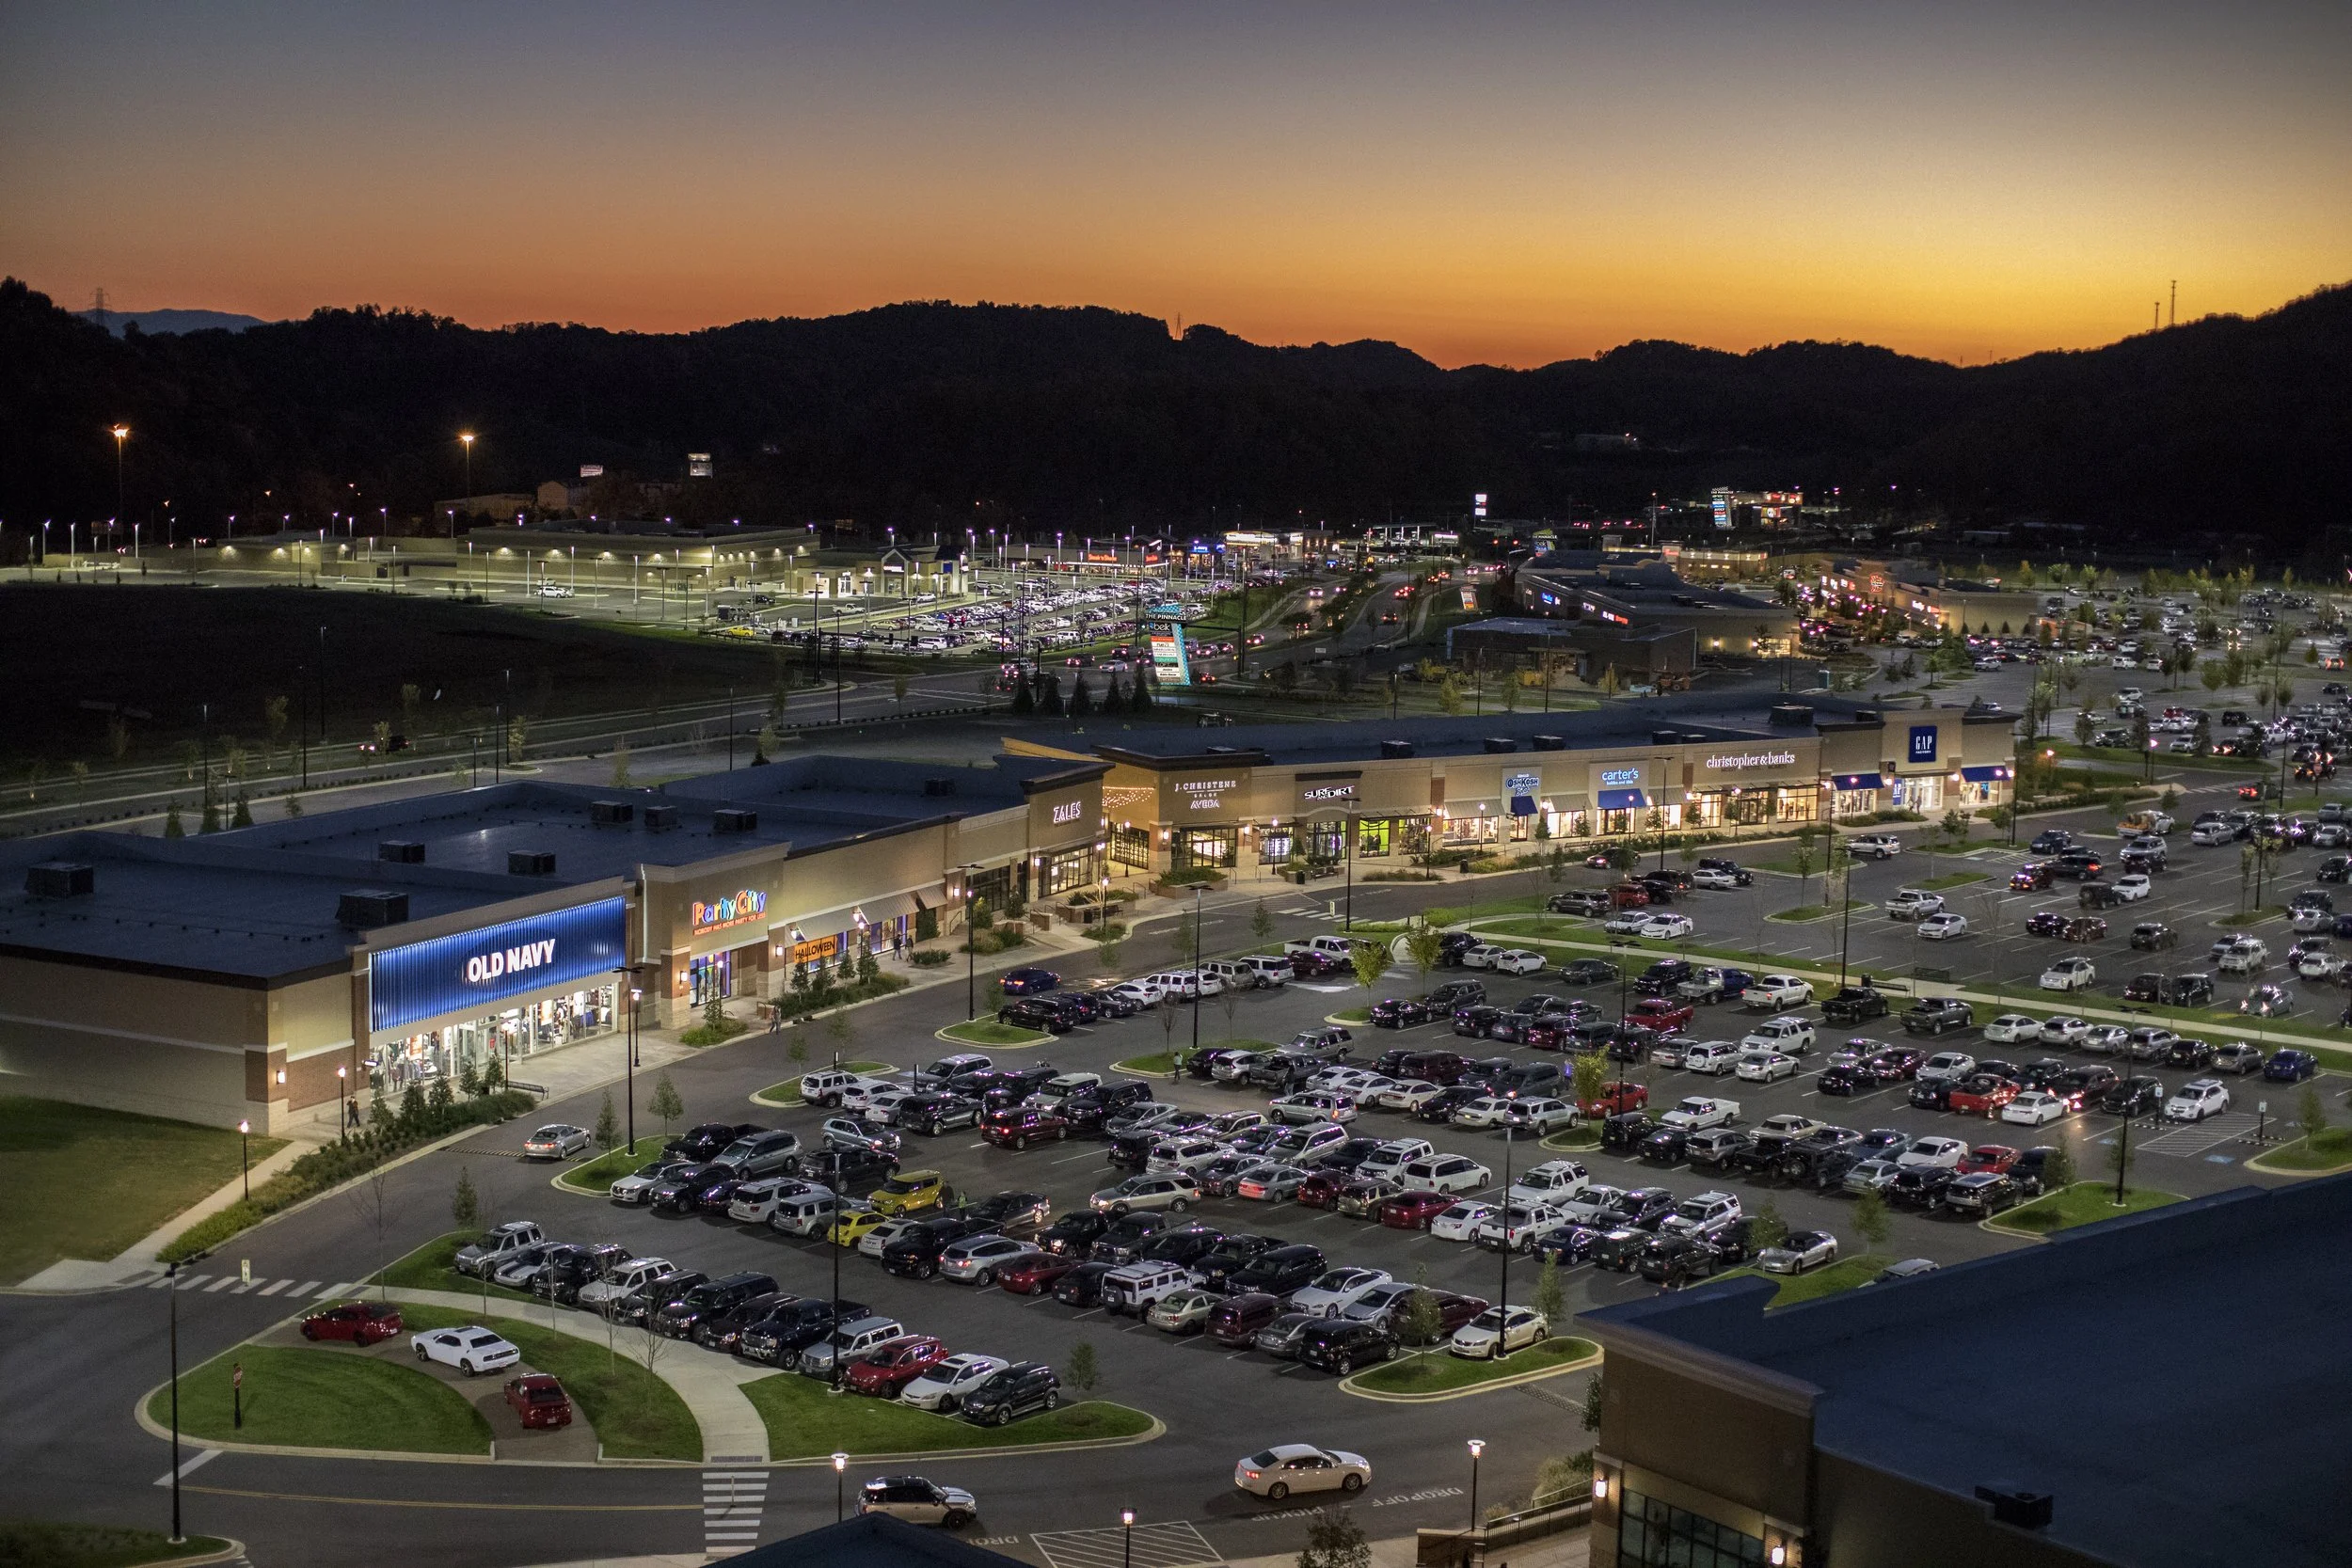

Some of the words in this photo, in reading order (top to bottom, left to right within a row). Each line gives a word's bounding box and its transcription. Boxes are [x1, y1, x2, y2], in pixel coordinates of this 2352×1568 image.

[1915, 736, 1931, 750] GAP
[1602, 768, 1639, 781] carter's
[1304, 786, 1332, 800] SURF
[1327, 785, 1355, 798] DIRT
[1190, 800, 1219, 809] AVEDA
[1054, 801, 1081, 823] ZALES
[795, 942, 835, 959] HALLOWEEN
[467, 952, 504, 983] OLD
[506, 939, 556, 974] NAVY
[1411, 1487, 1464, 1500] DROP
[1372, 1497, 1410, 1507] OFF
[1250, 1506, 1326, 1522] PICKUP
